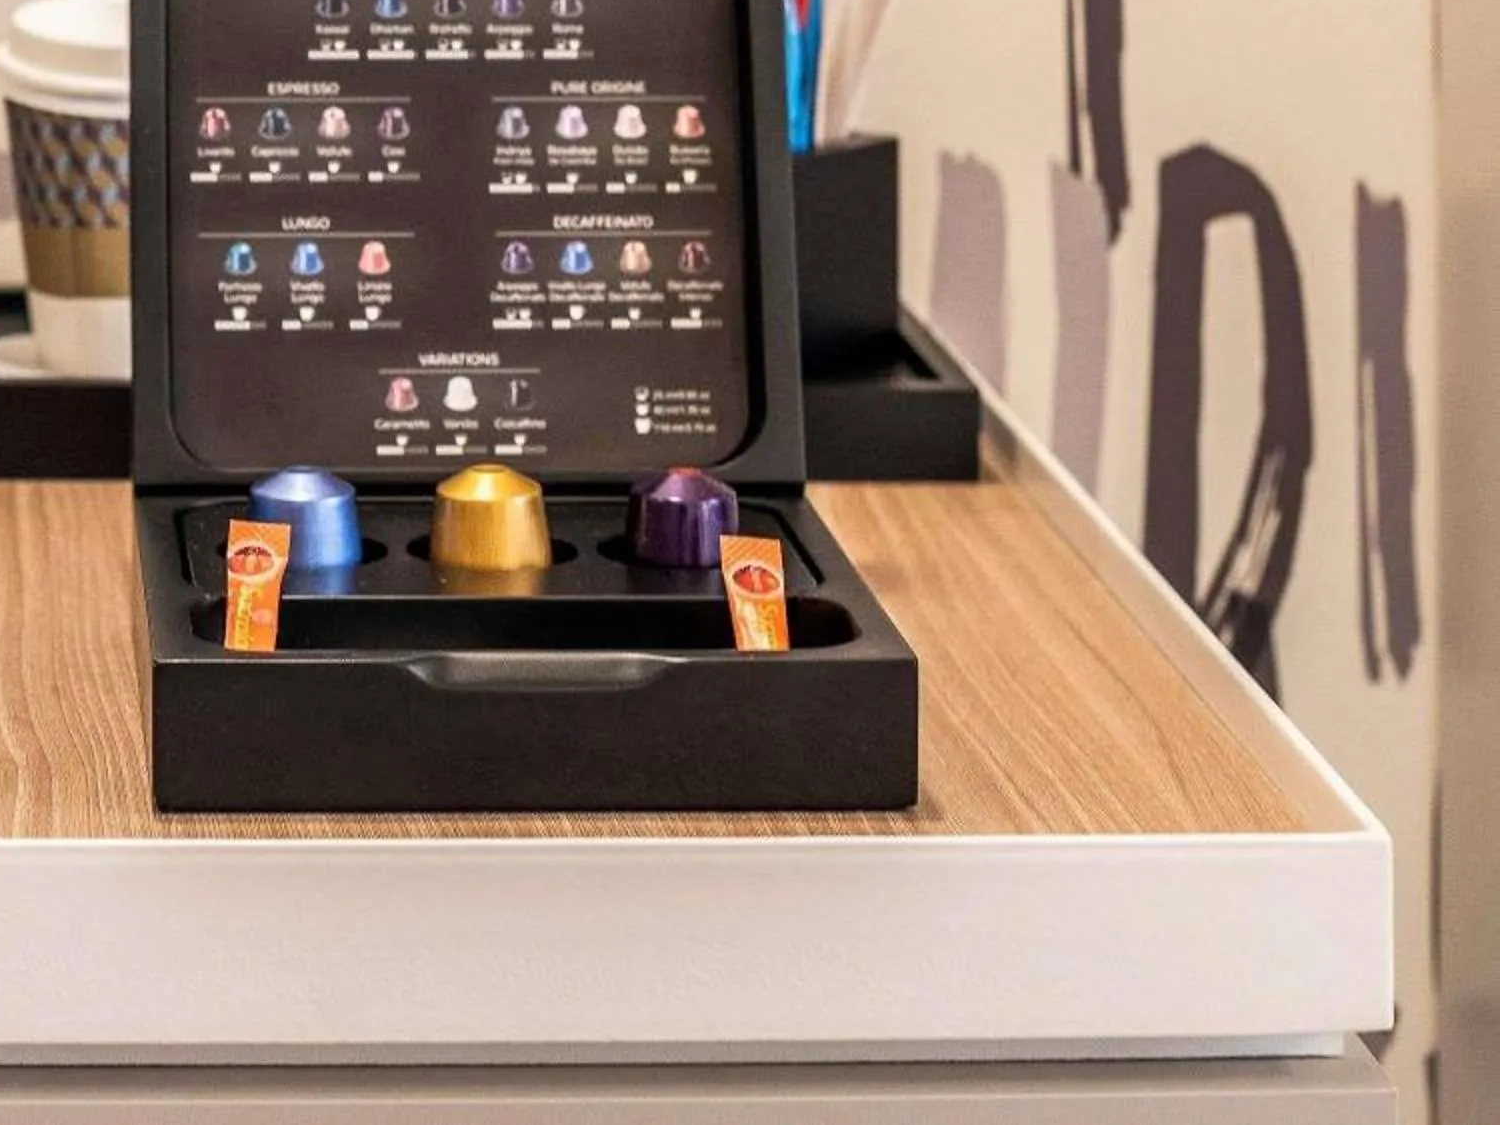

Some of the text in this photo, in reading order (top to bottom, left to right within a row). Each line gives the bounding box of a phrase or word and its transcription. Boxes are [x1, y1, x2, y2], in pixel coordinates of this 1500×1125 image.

[266, 82, 341, 95] ESPRESSO
[550, 81, 588, 94] PURE
[280, 217, 331, 231] LUNGO
[552, 215, 654, 229] DECAFFEINATO
[417, 352, 499, 366] VARIATIONS
